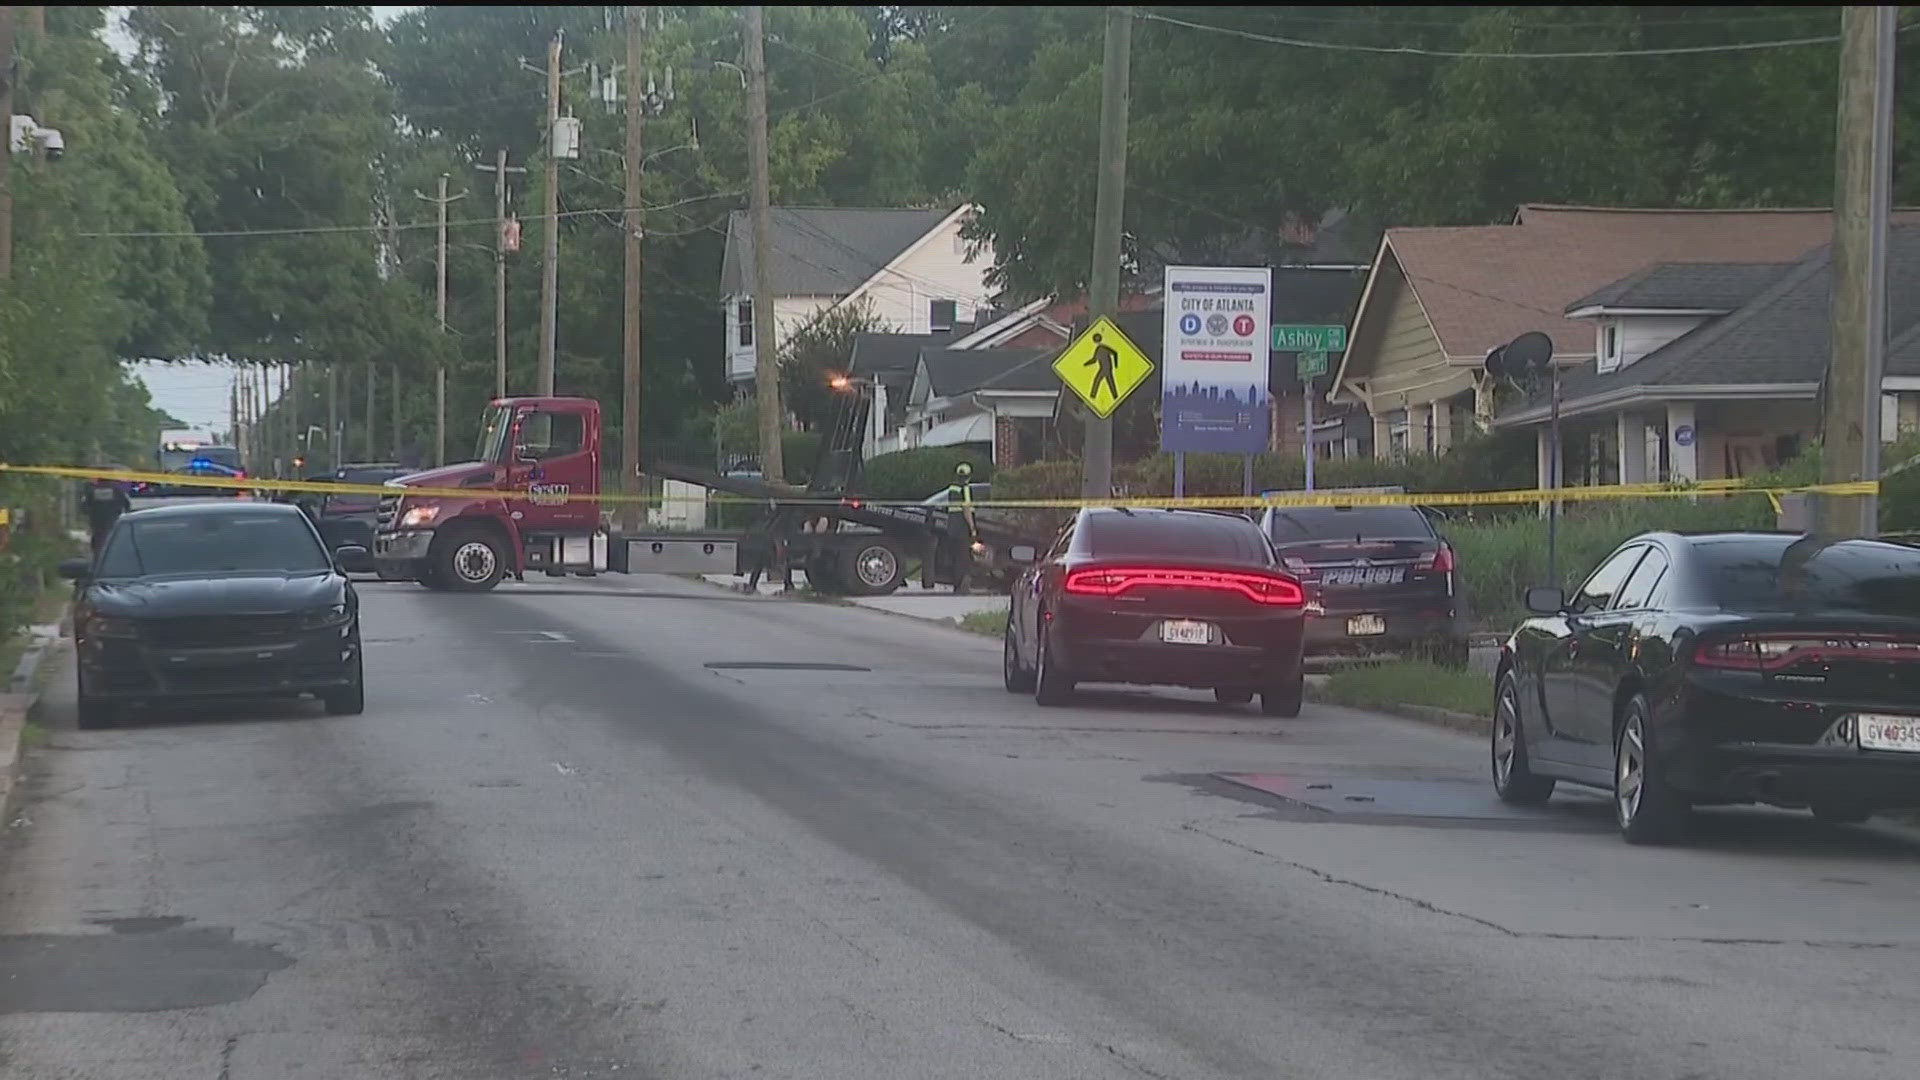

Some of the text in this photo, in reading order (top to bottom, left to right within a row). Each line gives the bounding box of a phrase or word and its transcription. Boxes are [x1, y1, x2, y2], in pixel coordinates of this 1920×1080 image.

[1181, 297, 1254, 312] CITY OF ATLANTA
[1185, 317, 1196, 332] D
[1239, 318, 1250, 333] T
[1277, 329, 1322, 351] Ashby
[1321, 567, 1406, 585] POLICE
